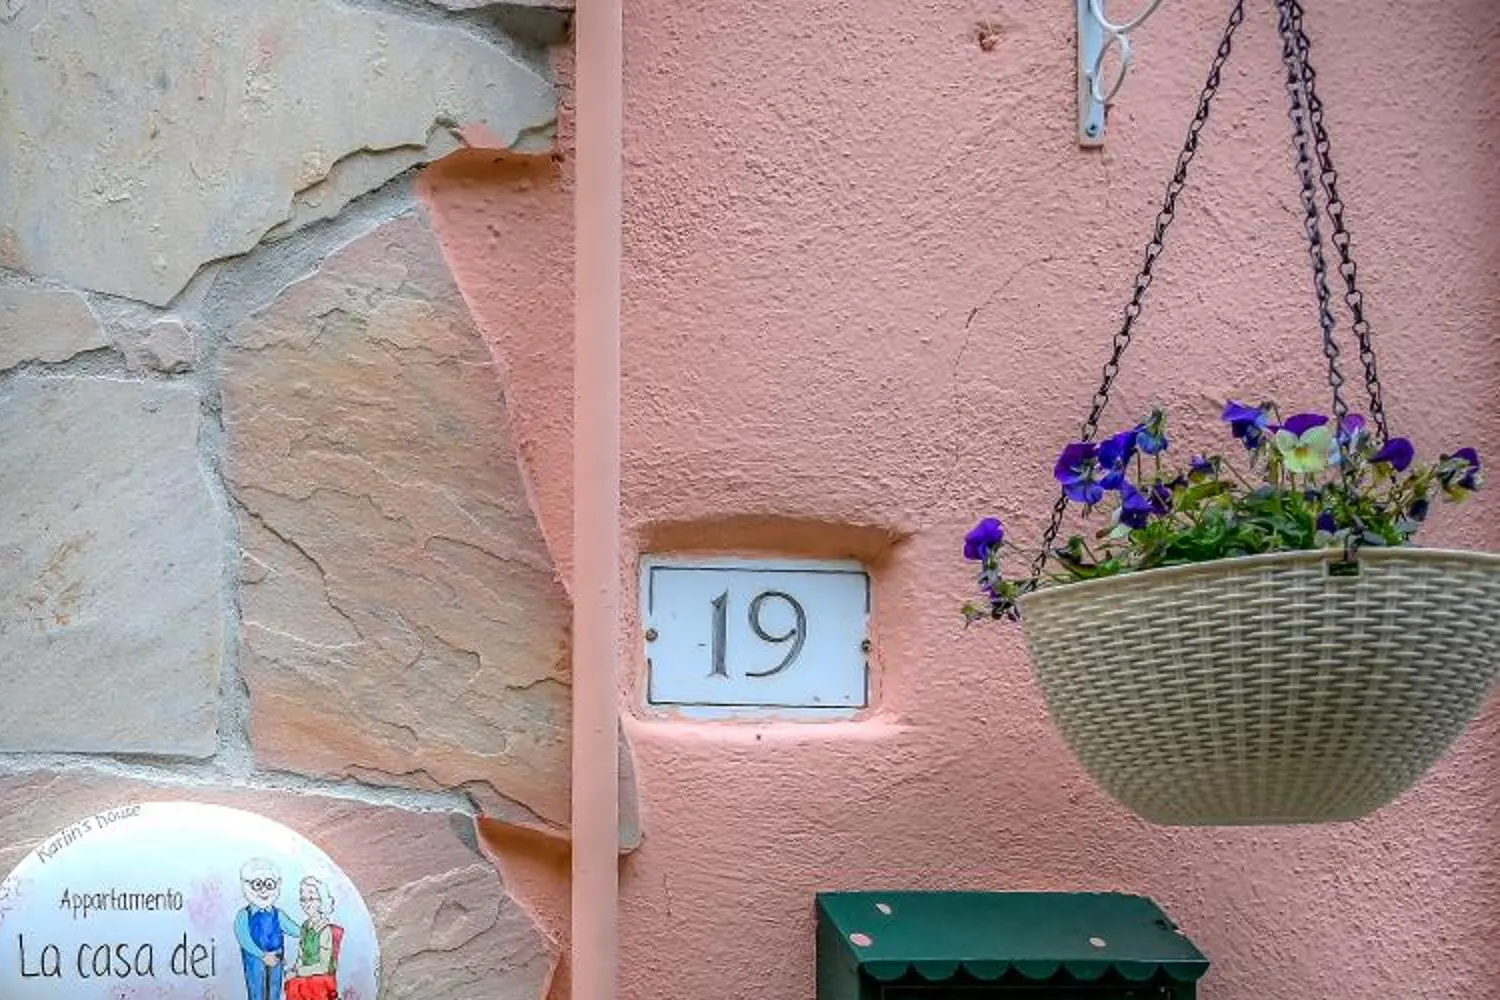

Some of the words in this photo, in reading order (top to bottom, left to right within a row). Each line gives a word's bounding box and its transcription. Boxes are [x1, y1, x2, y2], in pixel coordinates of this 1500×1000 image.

[707, 587, 807, 678] 19
[59, 888, 184, 920] Appartamento
[18, 933, 62, 978] La
[77, 942, 156, 979] casa
[170, 931, 216, 979] dei
